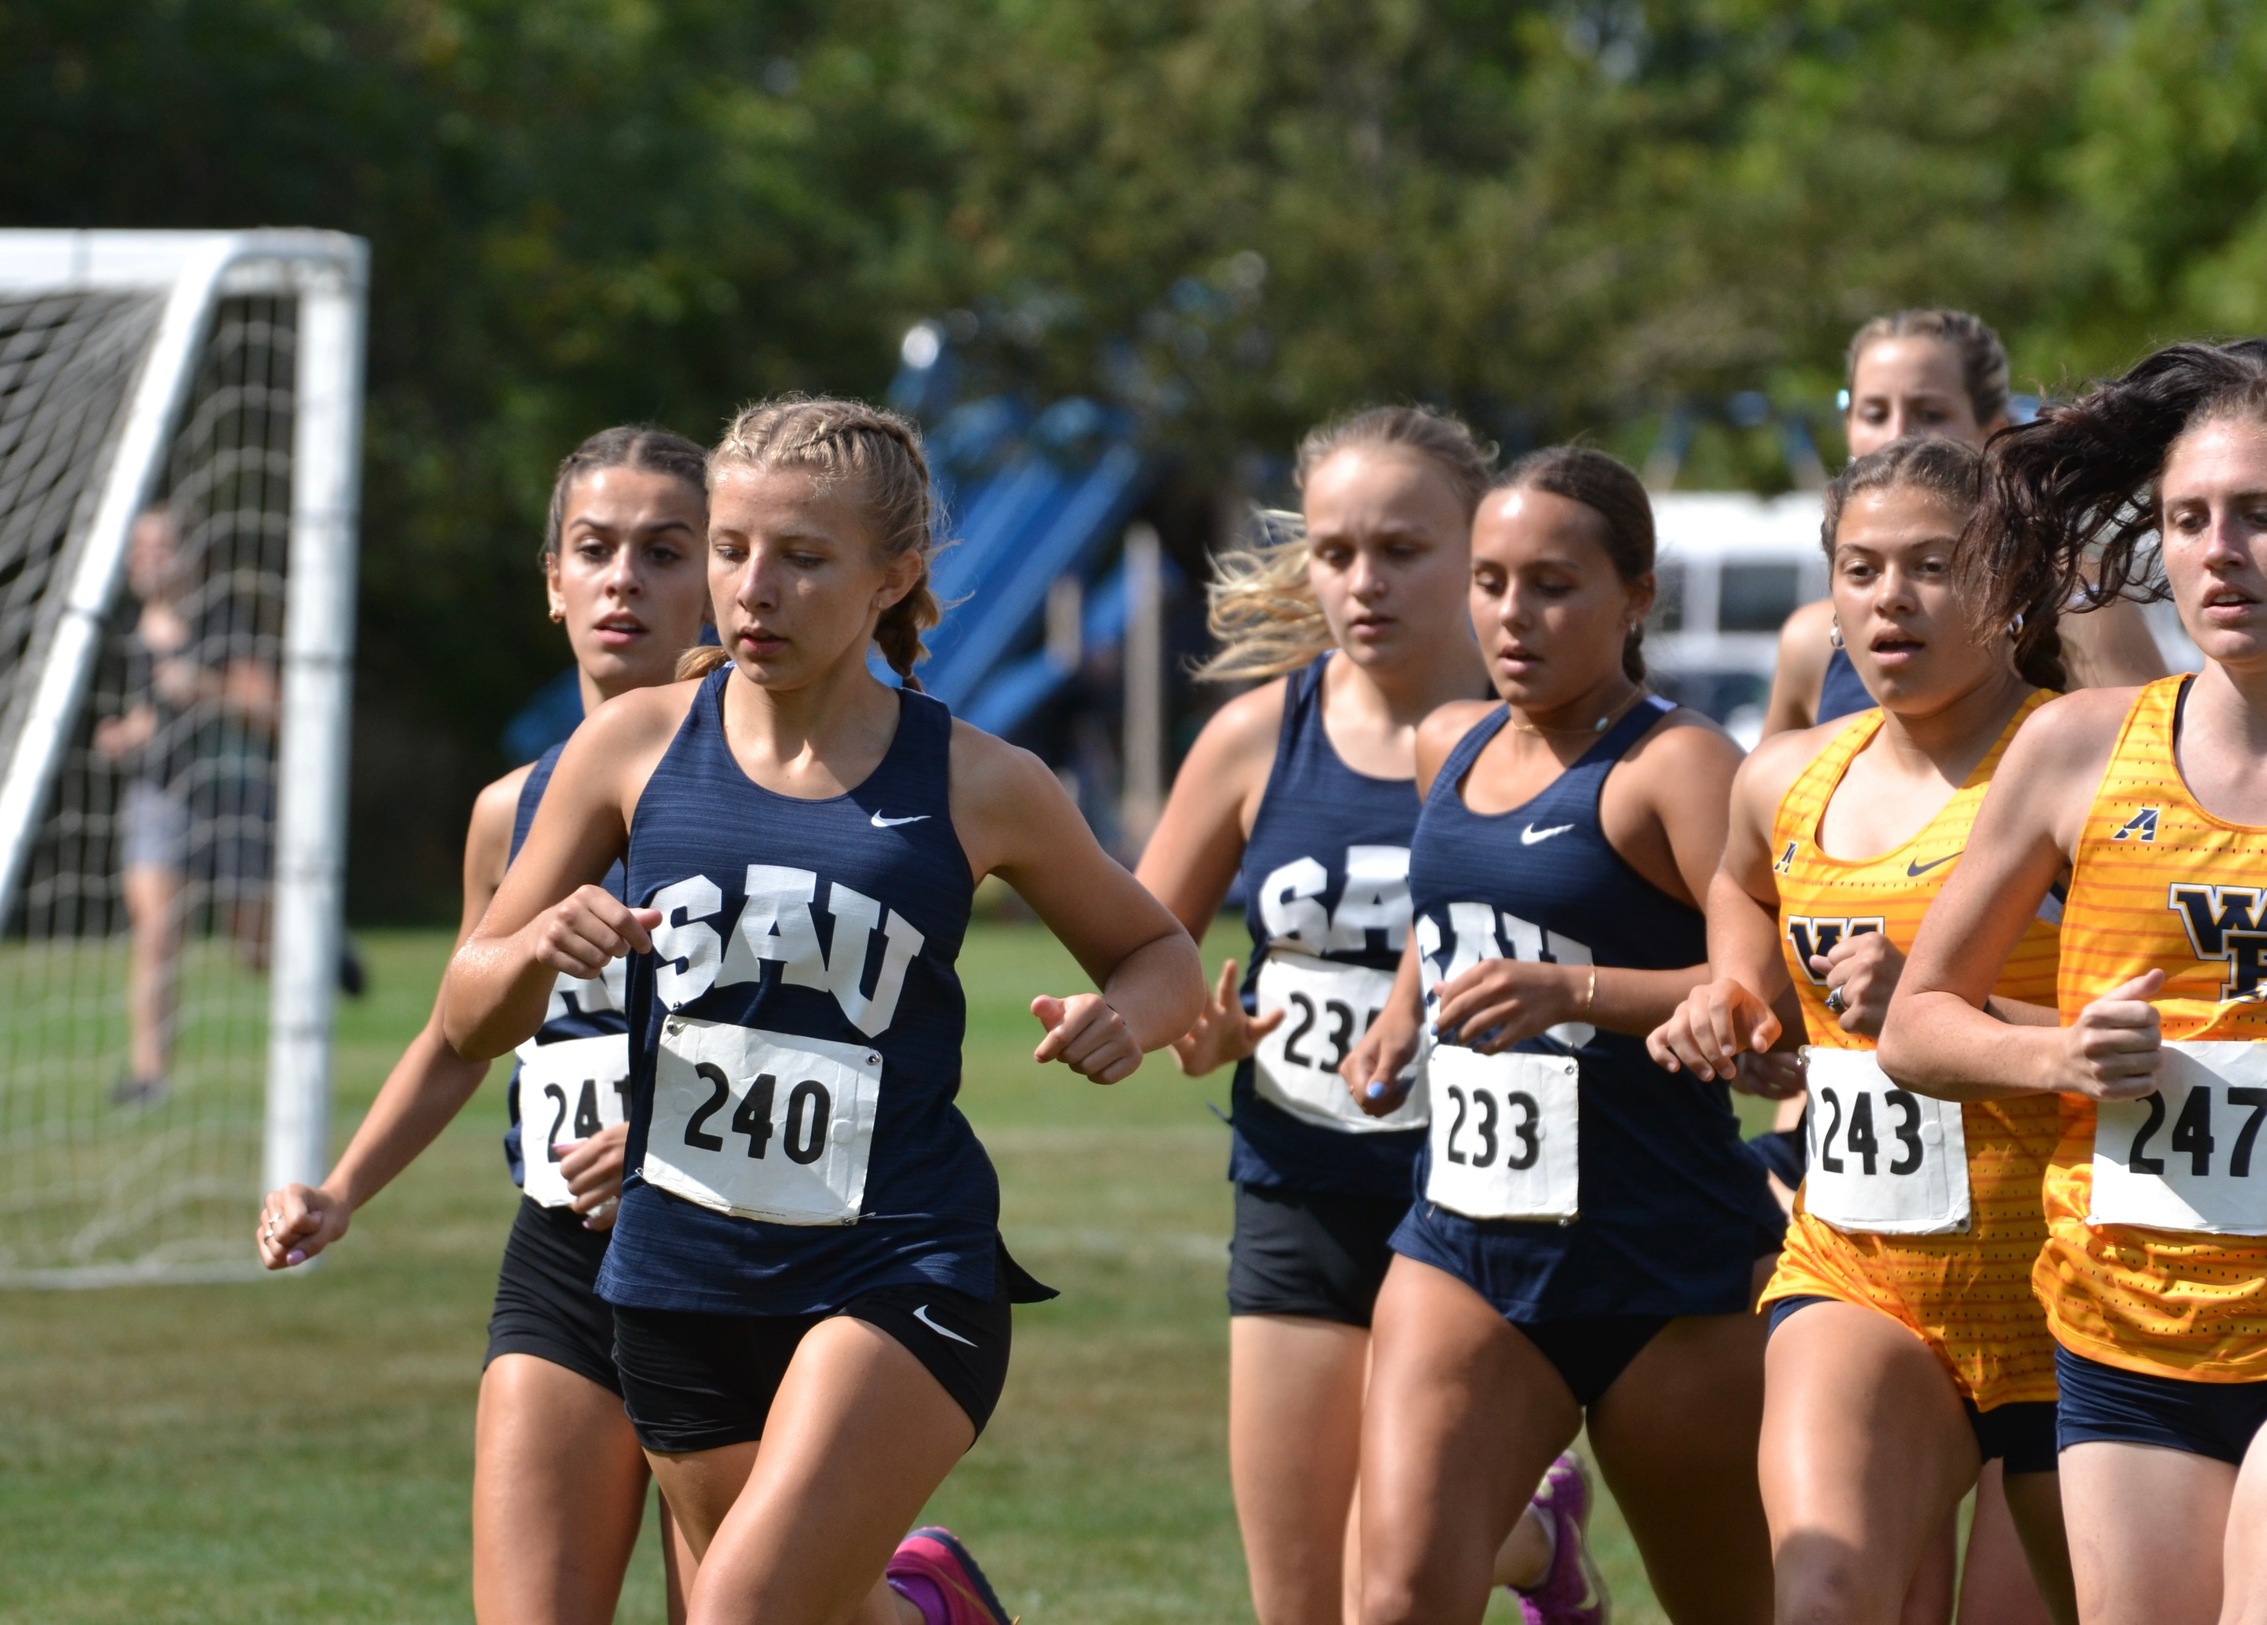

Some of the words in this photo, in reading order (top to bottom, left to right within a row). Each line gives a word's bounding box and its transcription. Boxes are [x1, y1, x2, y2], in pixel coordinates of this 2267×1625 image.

[1259, 845, 1414, 957] SA
[651, 864, 925, 1038] SAU
[1284, 989, 1383, 1074] 23
[684, 1062, 832, 1165] 240
[1447, 1084, 1542, 1170] 233
[1821, 1086, 1924, 1175] 243
[2129, 1085, 2267, 1178] 247
